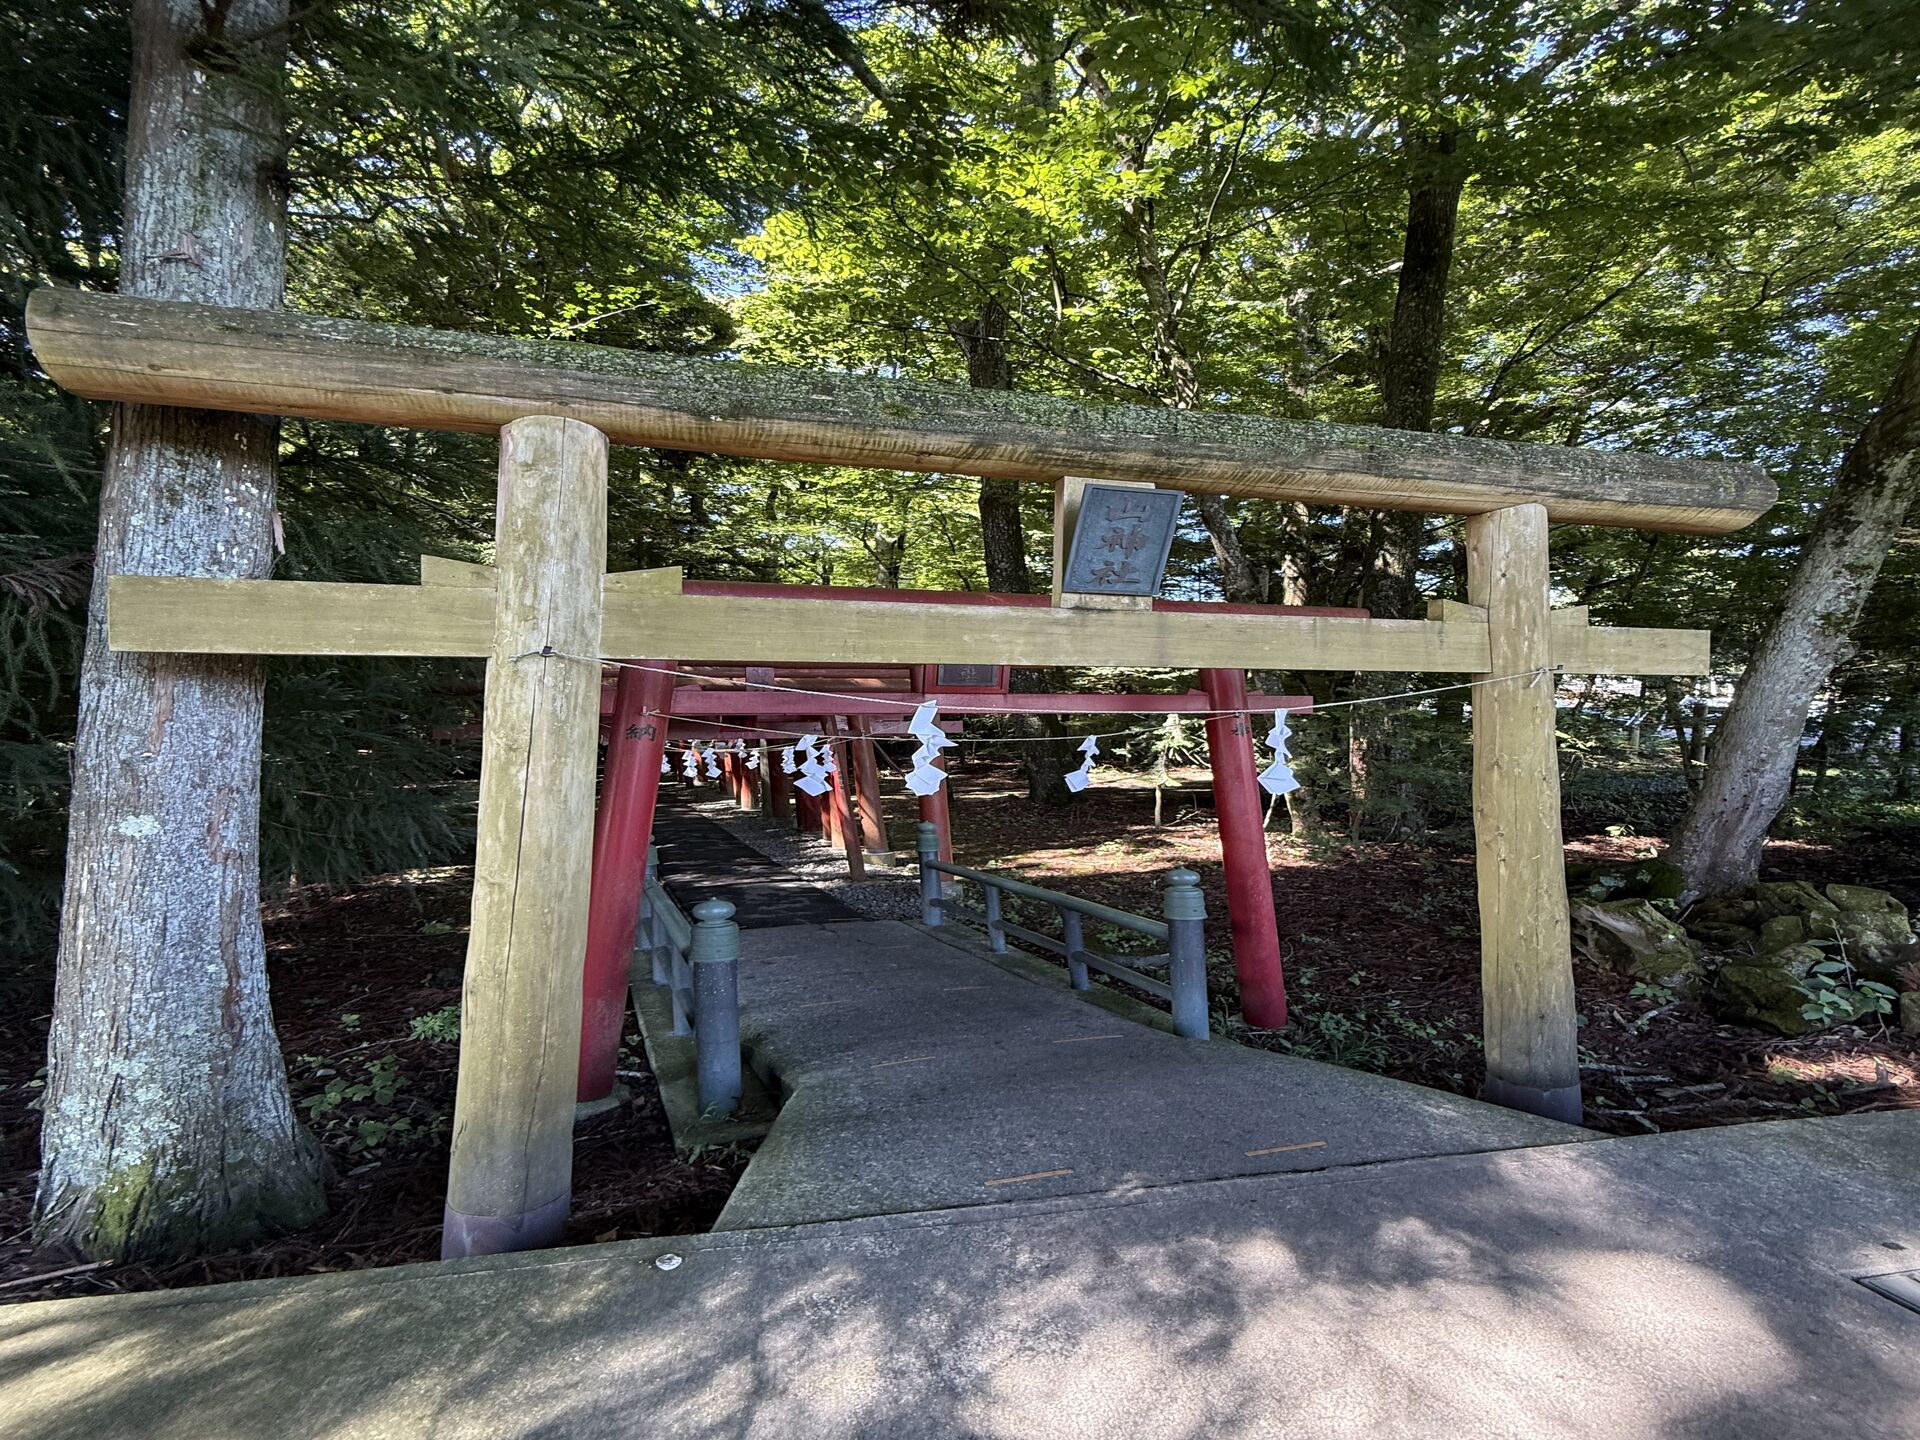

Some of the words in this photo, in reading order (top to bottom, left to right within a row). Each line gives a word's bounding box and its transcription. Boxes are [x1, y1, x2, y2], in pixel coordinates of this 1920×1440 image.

[1088, 501, 1151, 586] 山神社
[625, 723, 656, 741] 納
